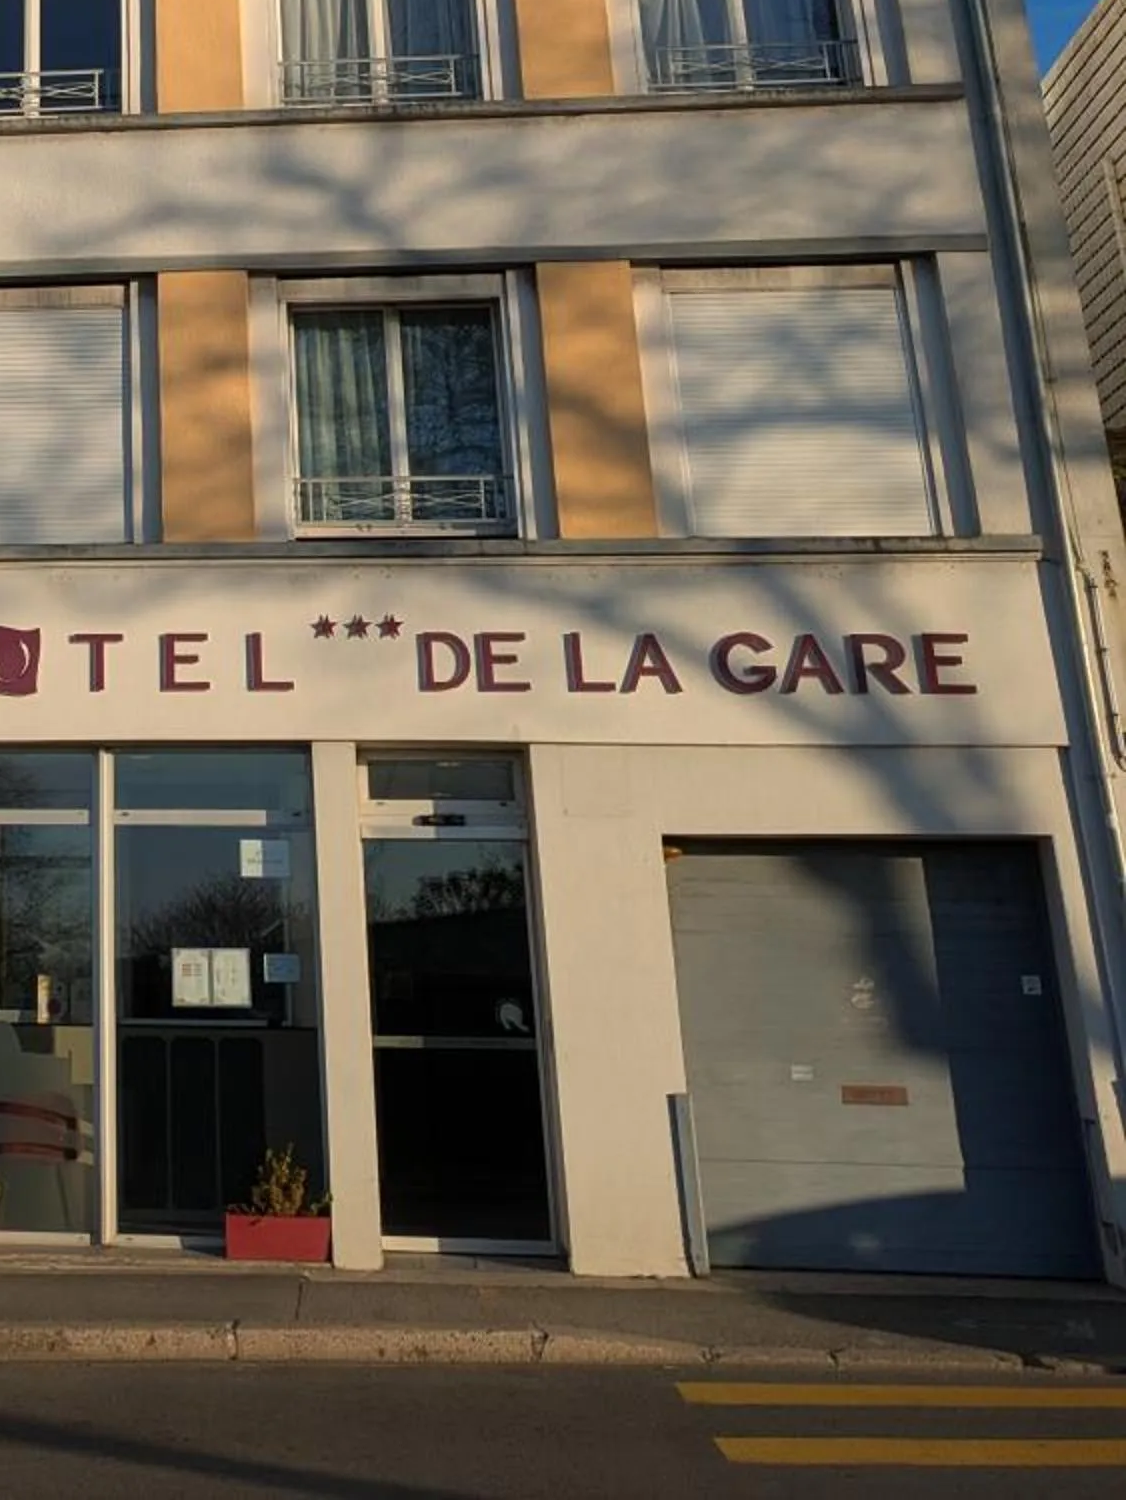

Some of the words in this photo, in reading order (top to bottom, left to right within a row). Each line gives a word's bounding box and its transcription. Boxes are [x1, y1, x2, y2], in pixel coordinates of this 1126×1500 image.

[416, 631, 532, 693] DE
[563, 631, 684, 694] LA
[708, 631, 978, 695] GARE
